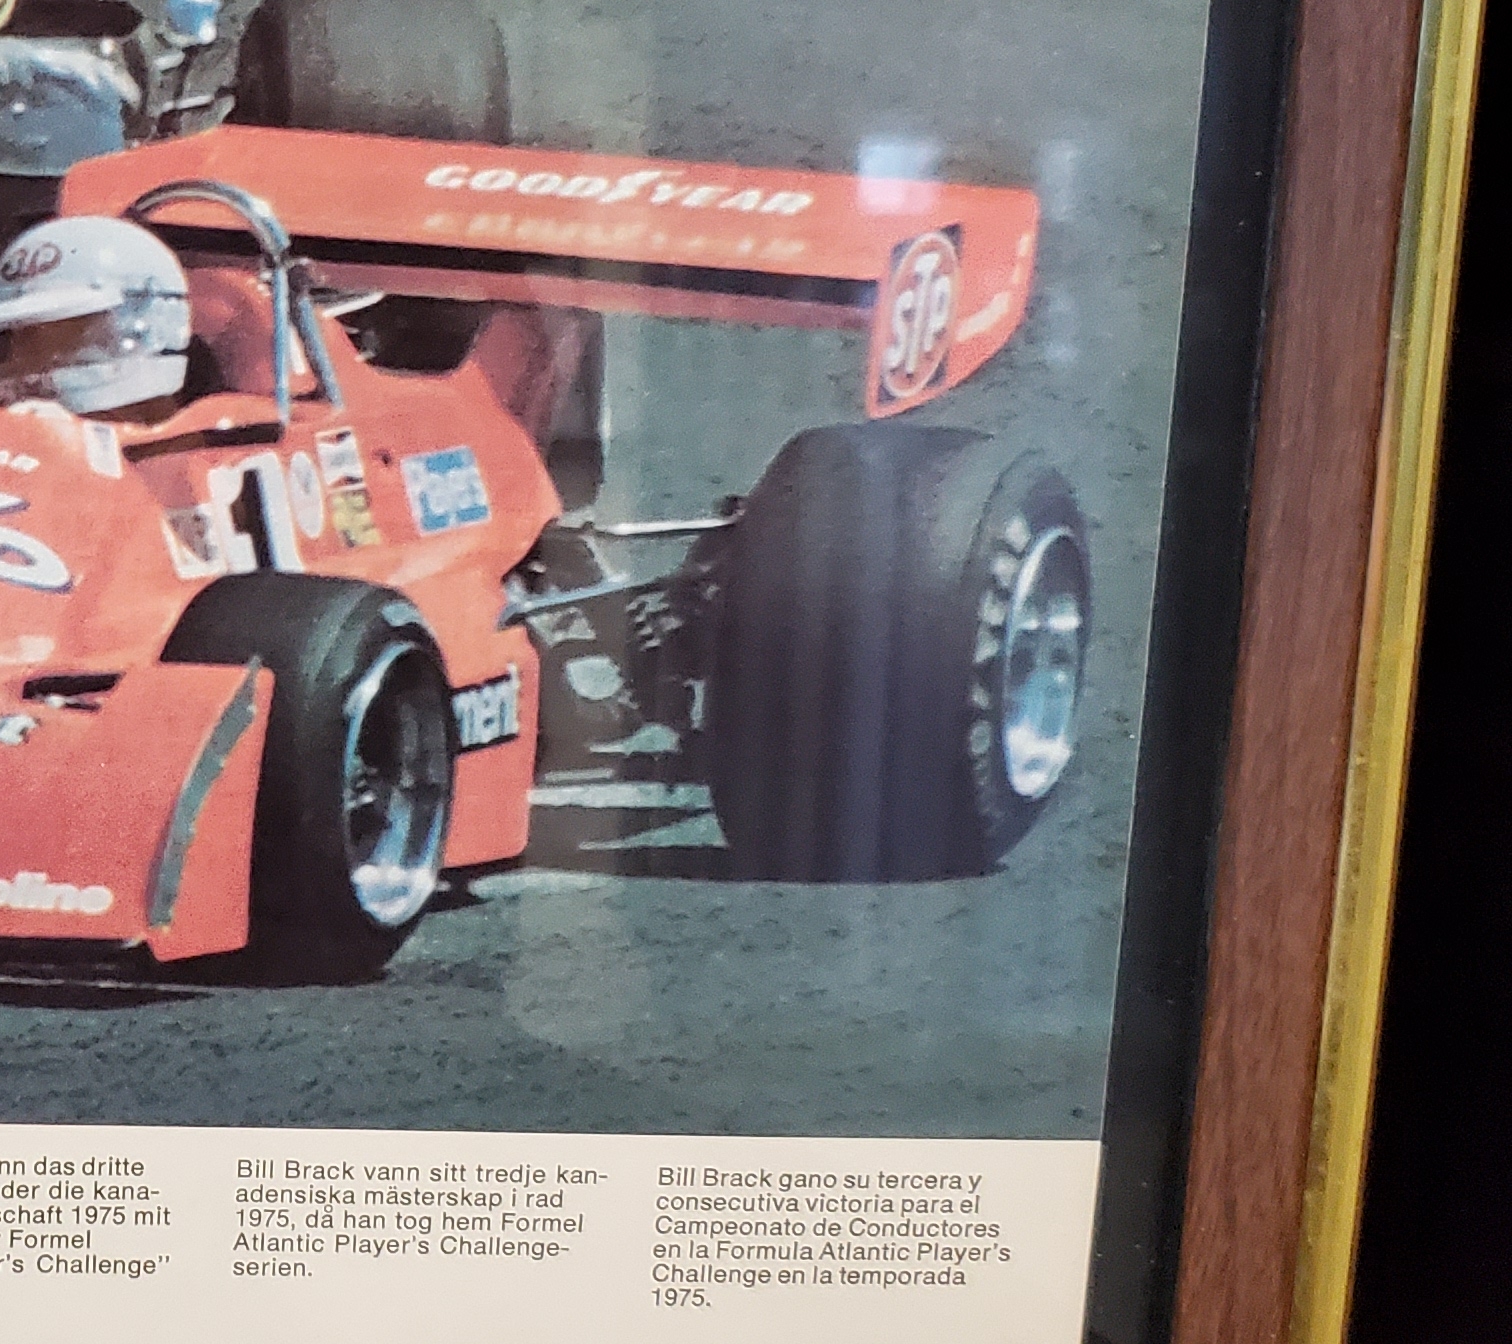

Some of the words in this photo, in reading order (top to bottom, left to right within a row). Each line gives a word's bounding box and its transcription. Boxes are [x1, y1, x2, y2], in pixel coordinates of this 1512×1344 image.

[424, 165, 814, 215] GOODYEAR
[882, 252, 952, 374] STP
[33, 1155, 76, 1176] das
[81, 1156, 145, 1177] dritte
[237, 1158, 274, 1179] Bill
[284, 1159, 355, 1181] Brack
[363, 1166, 420, 1182] vann
[429, 1162, 467, 1183] sitt
[475, 1163, 546, 1189] tredje
[556, 1164, 608, 1185] kan-
[48, 1179, 85, 1200] die
[93, 1180, 160, 1201] kana-
[658, 1166, 696, 1187] Bill
[703, 1167, 773, 1188] Brack
[778, 1173, 838, 1193] gano
[842, 1174, 870, 1189] su
[877, 1170, 963, 1190] tercera
[967, 1174, 983, 1195] y
[235, 1183, 356, 1205] adensiska
[364, 1185, 503, 1212] mästerskap
[511, 1187, 517, 1207] i
[525, 1189, 564, 1209] rad
[656, 1192, 800, 1213] consecutiva
[805, 1193, 895, 1214] victoria
[900, 1198, 954, 1218] para
[959, 1194, 981, 1214] el
[71, 1205, 126, 1226] 1975
[134, 1205, 171, 1226] mit
[236, 1208, 296, 1231] 1975,
[305, 1203, 334, 1229] då
[343, 1209, 386, 1230] han
[394, 1211, 432, 1235] tog
[442, 1211, 491, 1231] hem
[501, 1212, 584, 1233] Formel
[655, 1215, 806, 1240] Campeonato
[812, 1217, 842, 1237] de
[848, 1217, 1001, 1238] Conductores
[9, 1229, 91, 1250] Formel
[232, 1231, 325, 1253] Atlantic
[334, 1234, 430, 1258] Player's
[440, 1235, 570, 1261] Challenge-
[653, 1243, 681, 1259] en
[689, 1239, 710, 1259] la
[716, 1240, 814, 1261] Formula
[818, 1241, 911, 1261] Atlantic
[917, 1242, 1011, 1266] Player's
[232, 1257, 313, 1277] serien.
[652, 1263, 772, 1288] Challenge
[777, 1269, 805, 1285] en
[812, 1265, 833, 1285] la
[838, 1266, 967, 1290] temporada
[651, 1287, 711, 1307] 1975.
